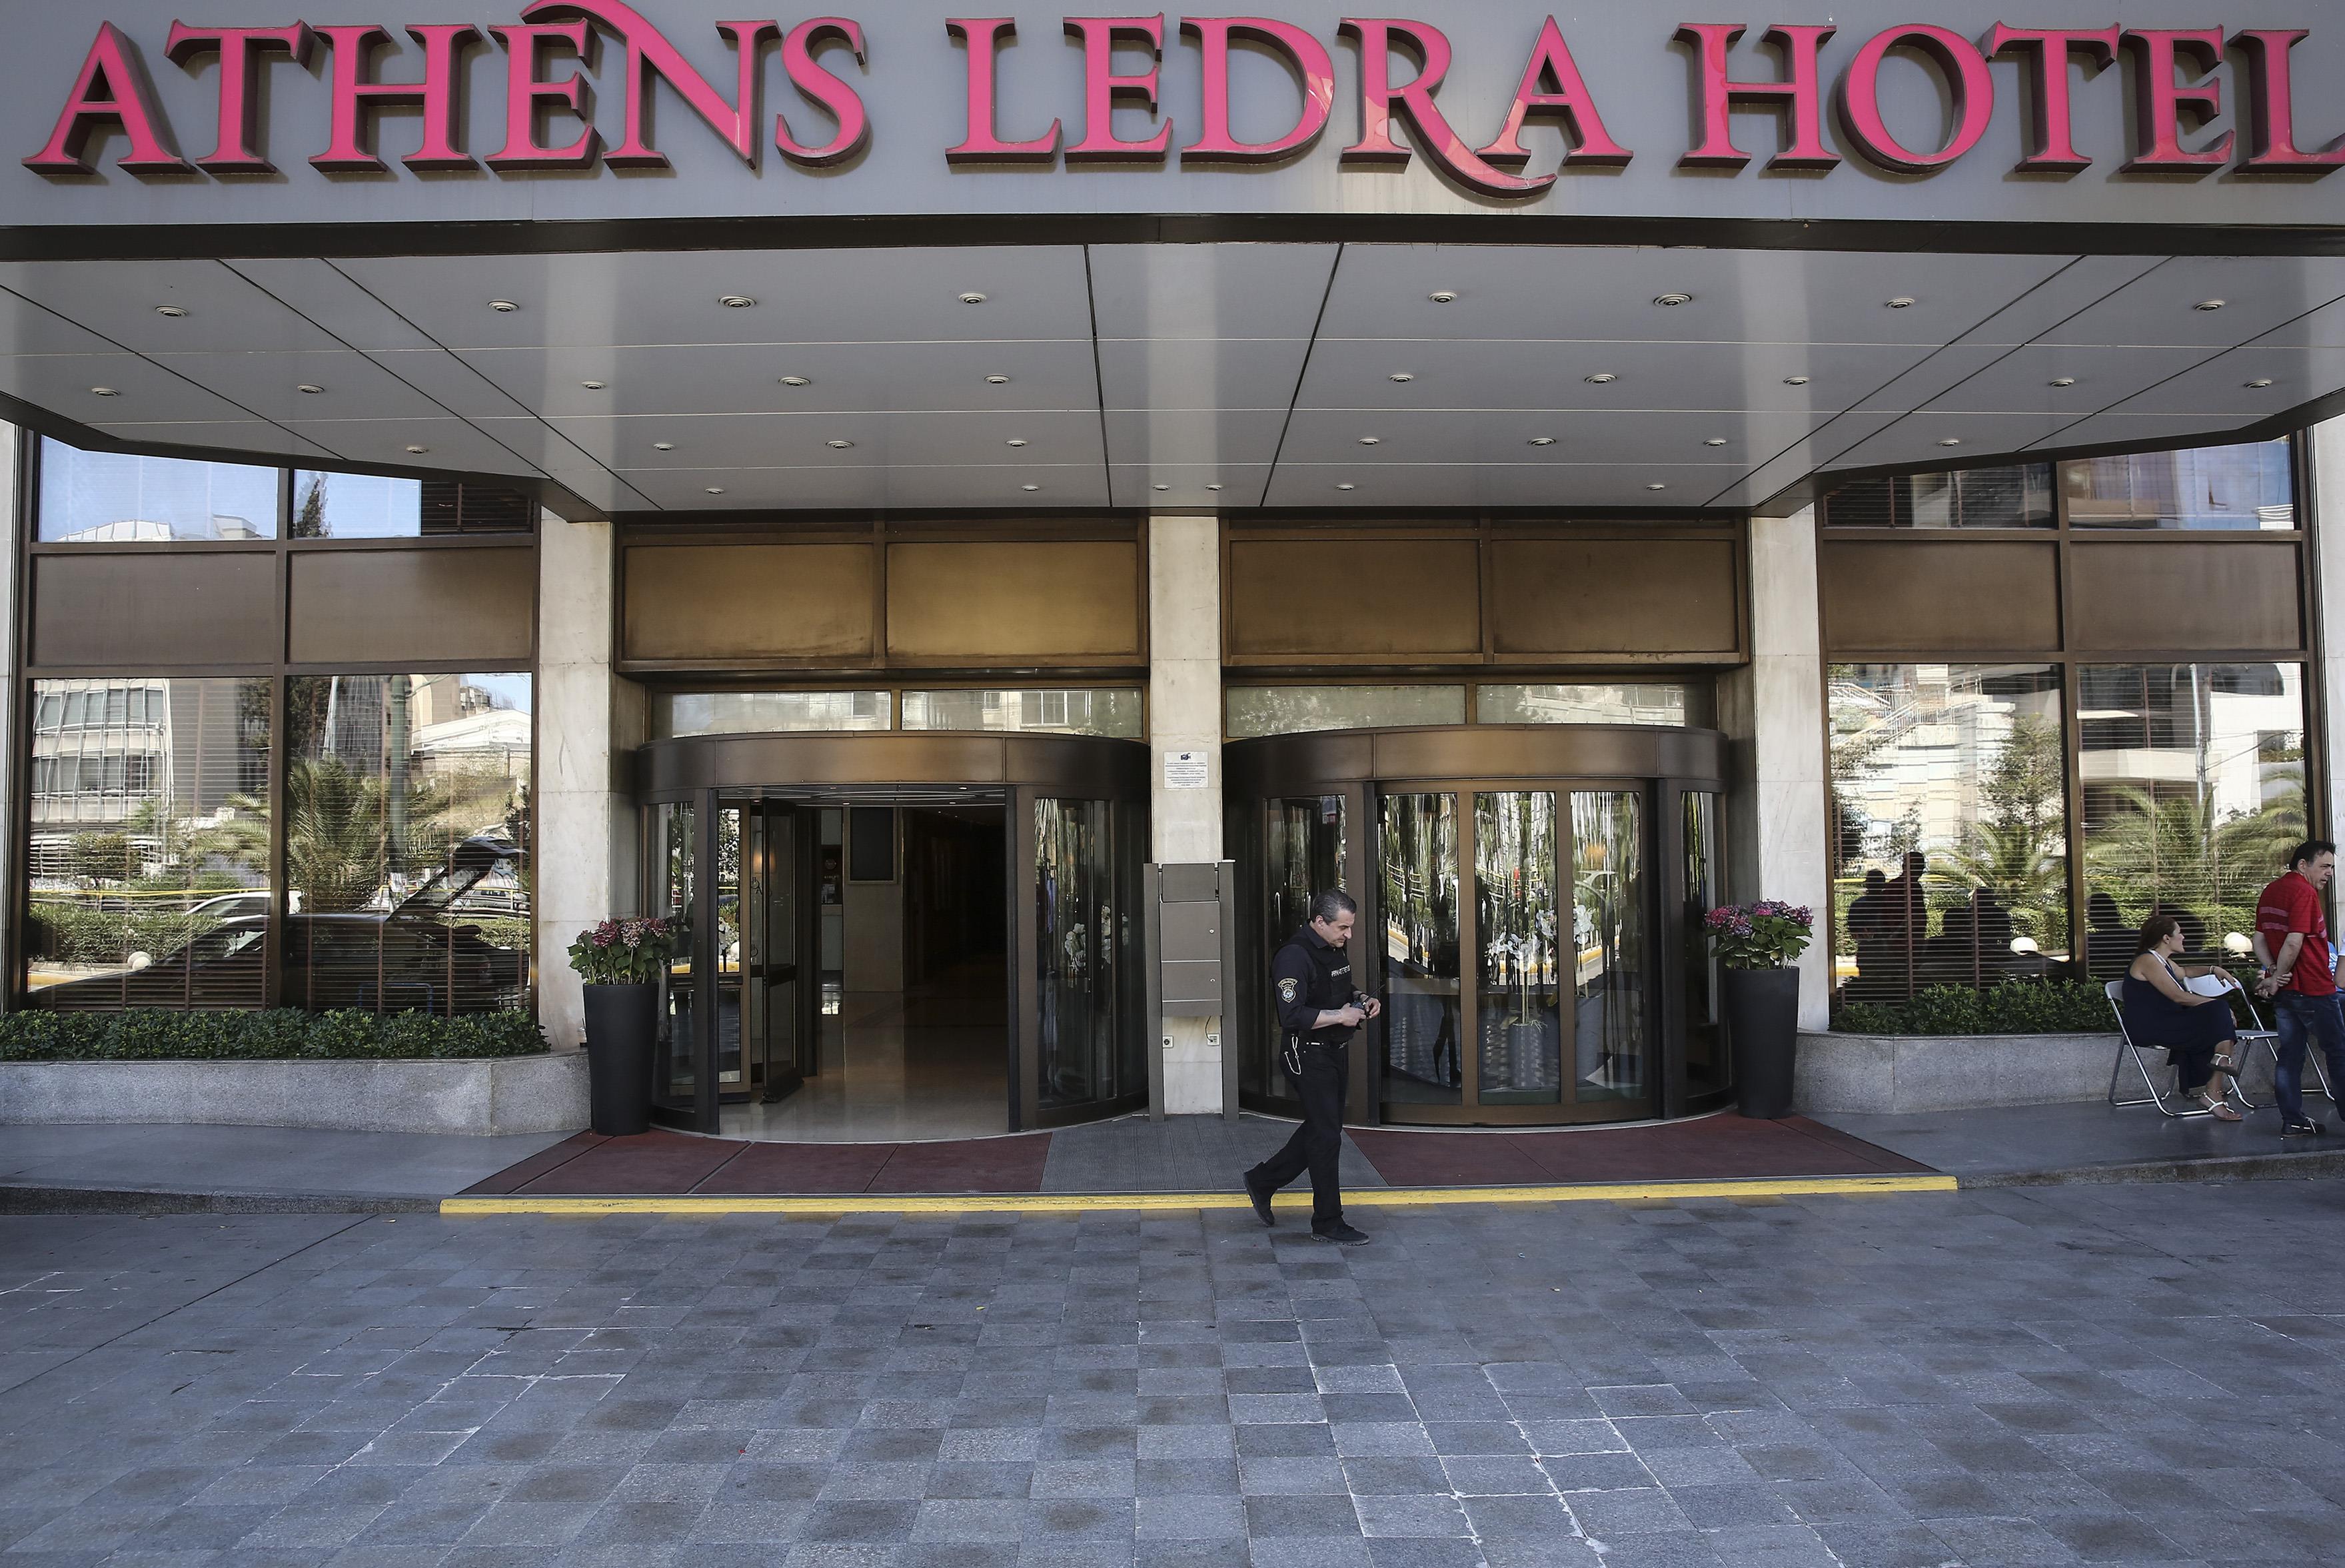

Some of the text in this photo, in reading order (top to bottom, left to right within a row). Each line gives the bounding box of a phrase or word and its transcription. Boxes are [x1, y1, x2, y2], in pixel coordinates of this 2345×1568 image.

[21, 0, 2345, 199] ATHENS LEDRA HOTEL
